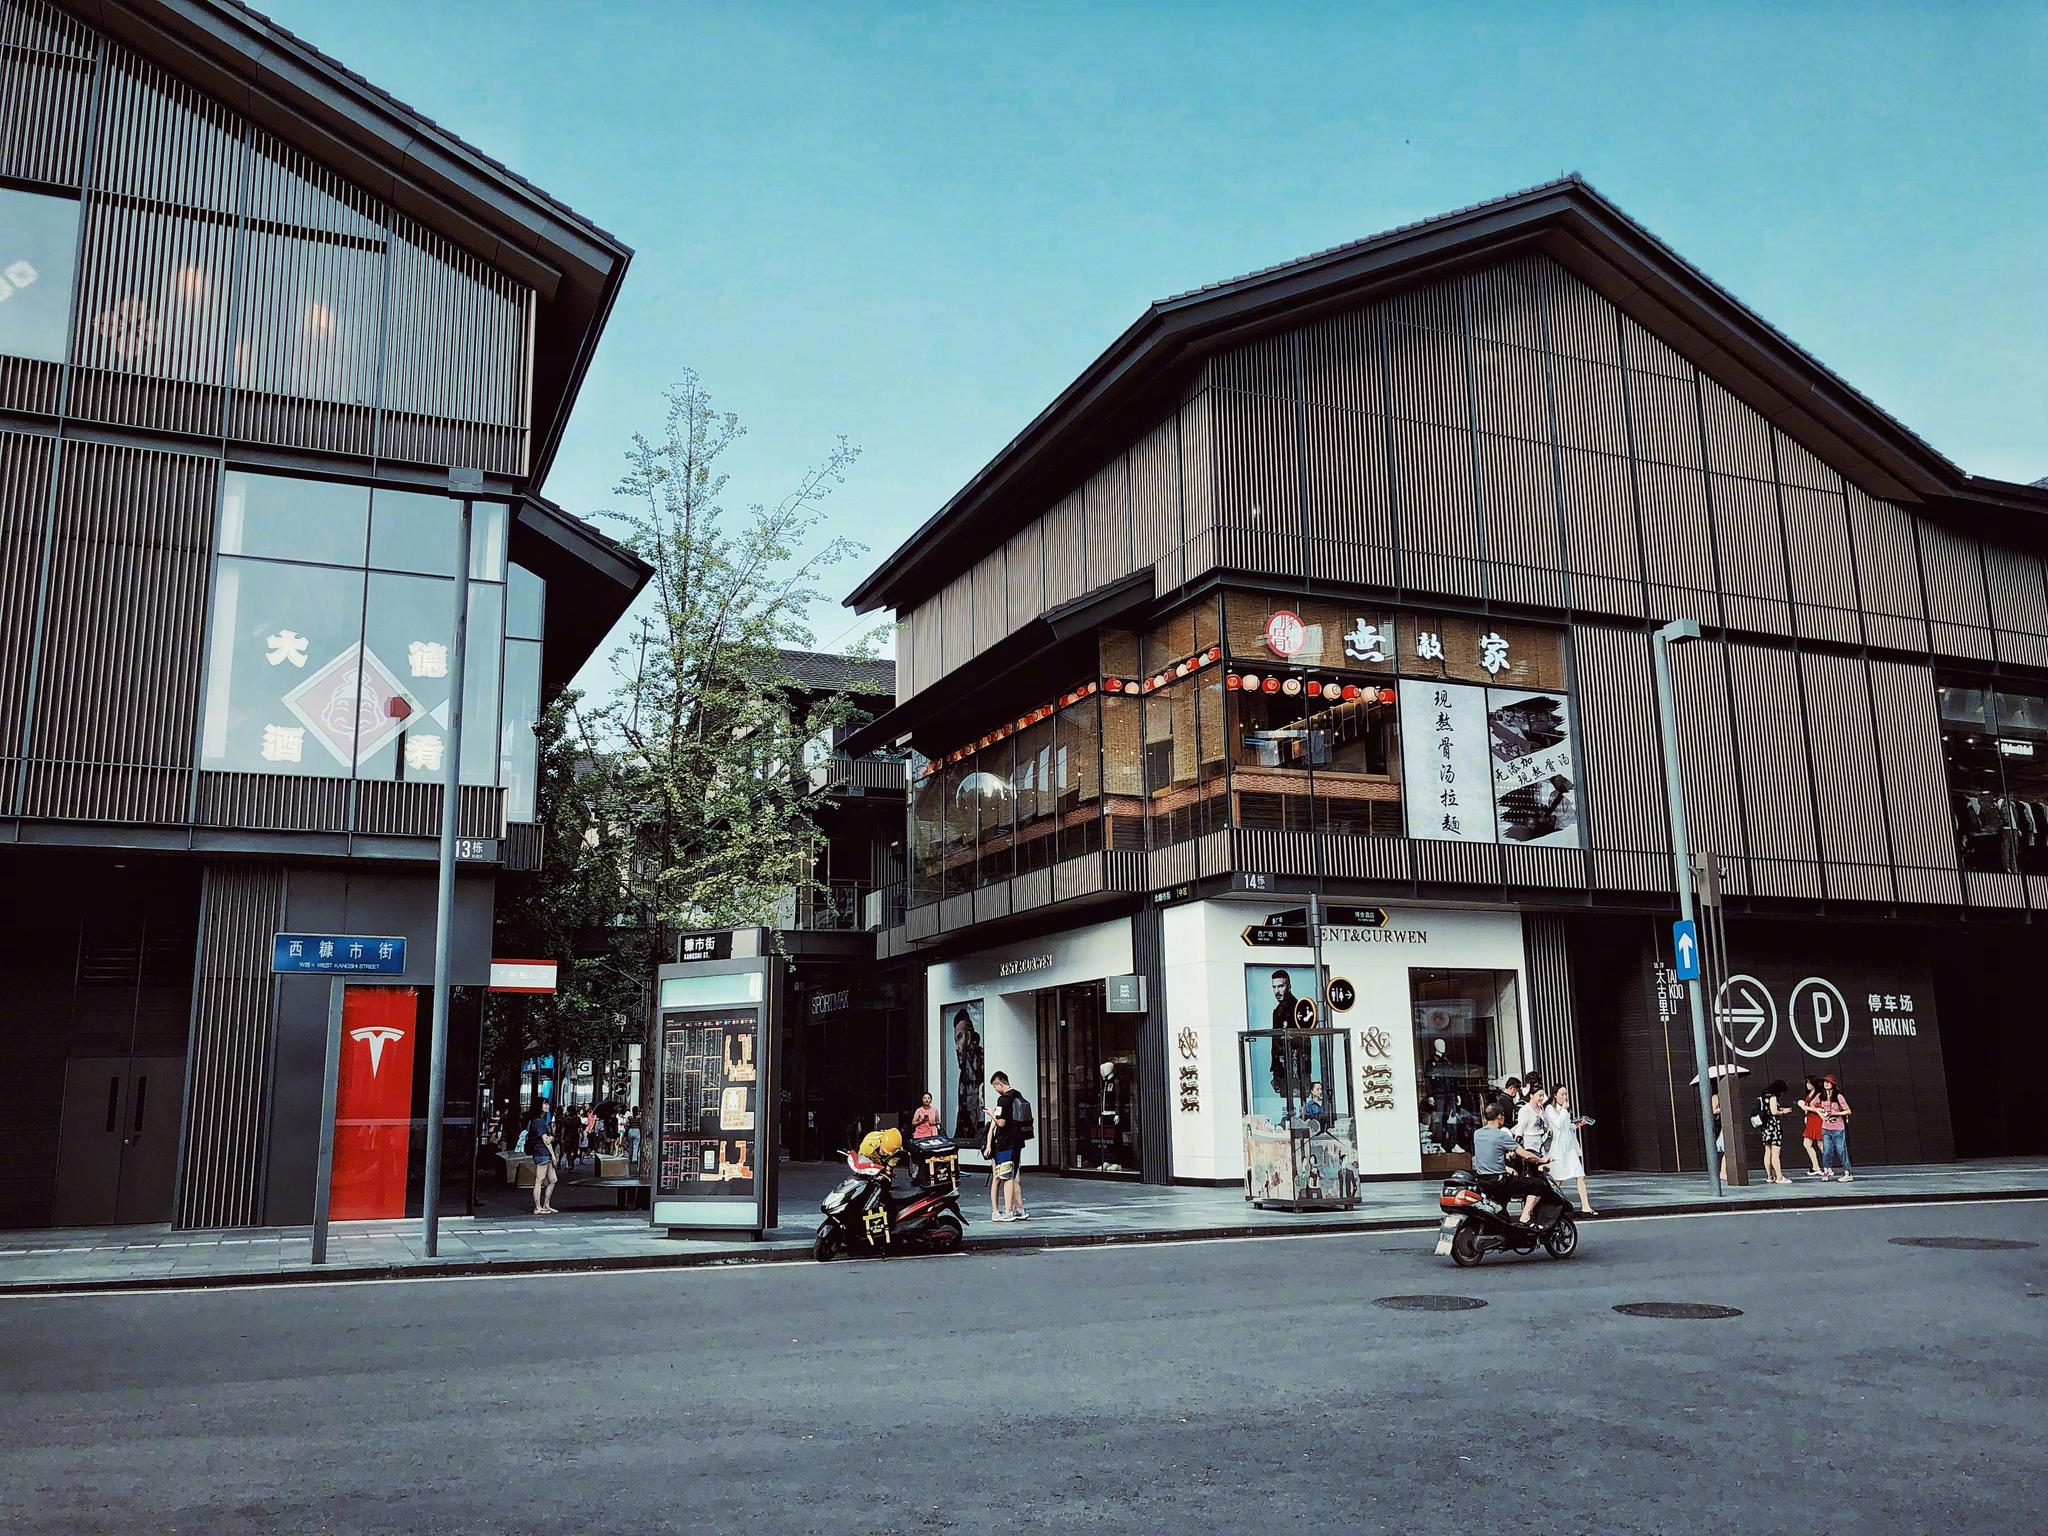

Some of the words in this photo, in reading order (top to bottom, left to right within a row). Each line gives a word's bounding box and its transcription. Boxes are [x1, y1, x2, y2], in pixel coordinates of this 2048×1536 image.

[1318, 927, 1428, 944] ENT&CURWEN
[289, 940, 393, 960] 西糠市街
[1655, 969, 1670, 1015] 太古里
[1668, 984, 1684, 999] KOO
[1868, 993, 1914, 1012] 停车场
[1872, 1017, 1917, 1036] PARKING
